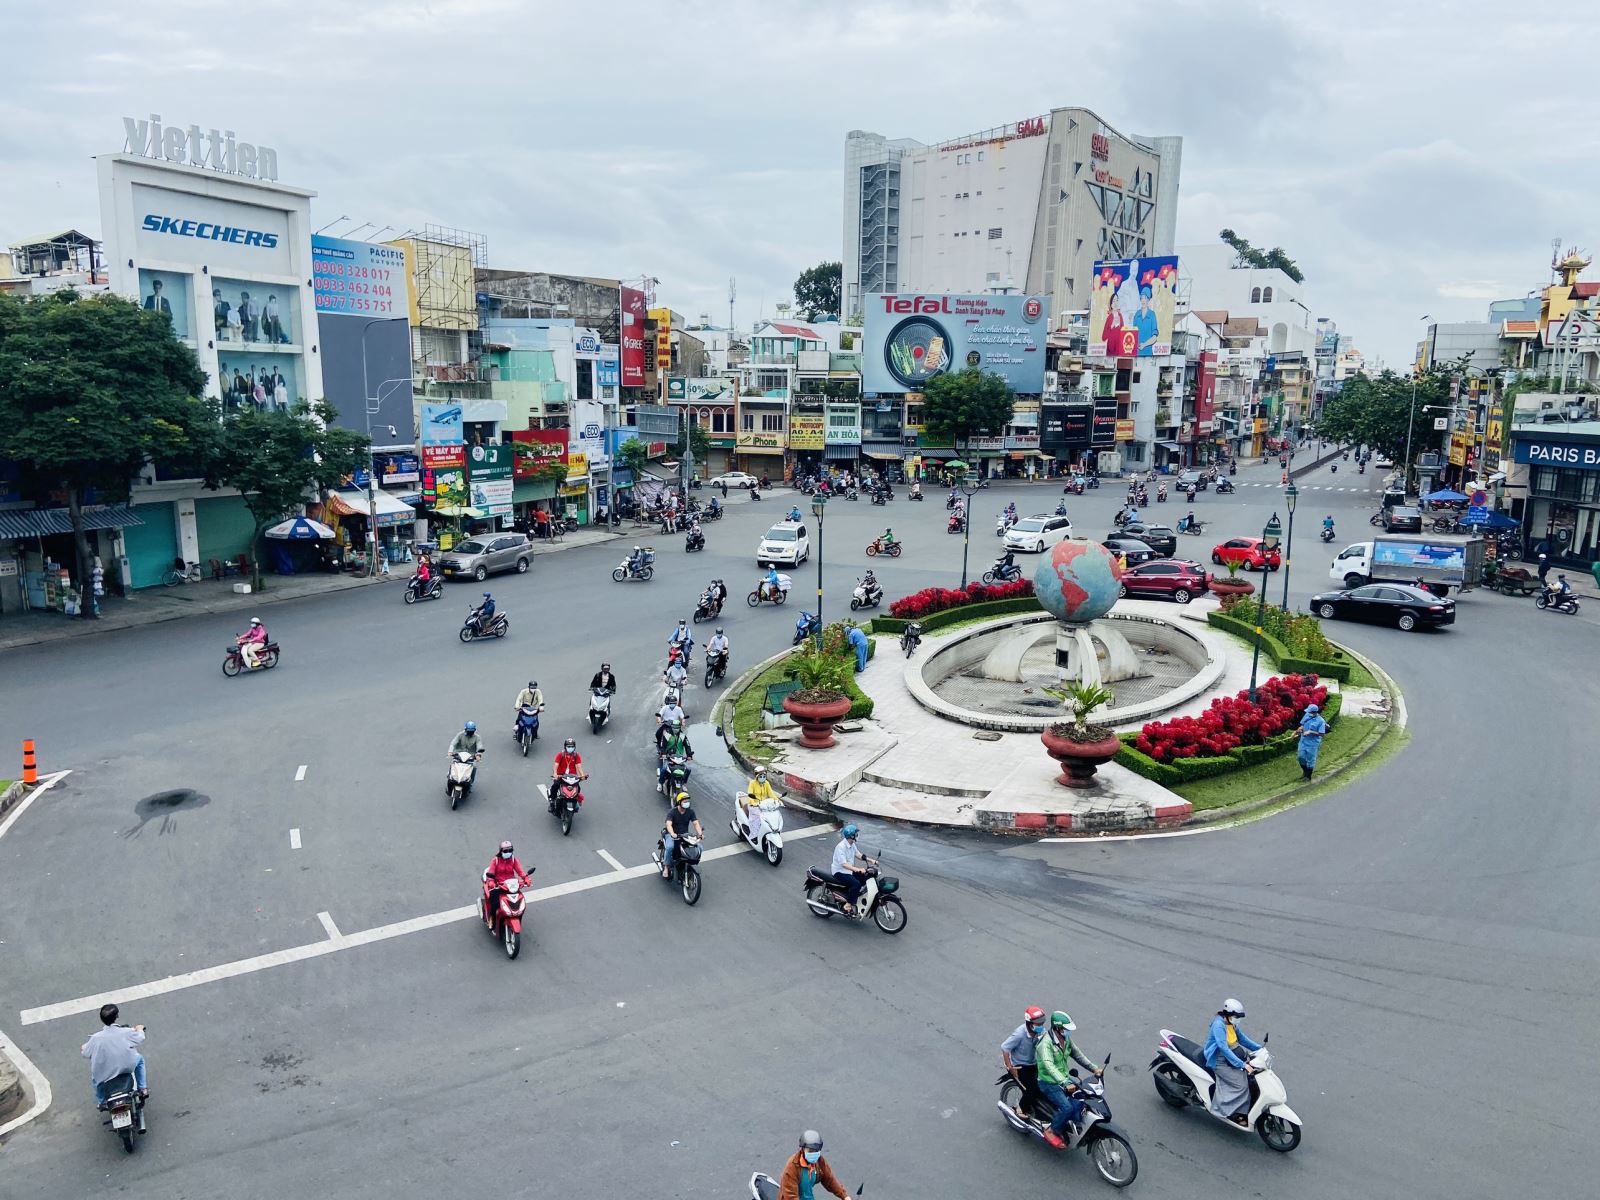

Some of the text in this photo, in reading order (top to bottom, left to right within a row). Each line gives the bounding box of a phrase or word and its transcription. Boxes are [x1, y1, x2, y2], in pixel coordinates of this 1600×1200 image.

[1017, 117, 1044, 134] GALA
[940, 144, 969, 153] WEDDING
[1092, 134, 1109, 155] GALA
[142, 214, 278, 249] SKECHERS
[370, 248, 405, 260] PACIFIC
[314, 261, 391, 281] 0908 328 017
[315, 278, 392, 297] 0933 462 404
[316, 295, 346, 308] 0977
[350, 298, 370, 310] 755
[880, 296, 953, 314] Tefal
[582, 339, 594, 349] ECO
[628, 338, 643, 349] GREE
[586, 426, 598, 436] ECO
[827, 431, 839, 439] AN
[450, 446, 463, 454] BAY
[1529, 445, 1579, 463] PARIS
